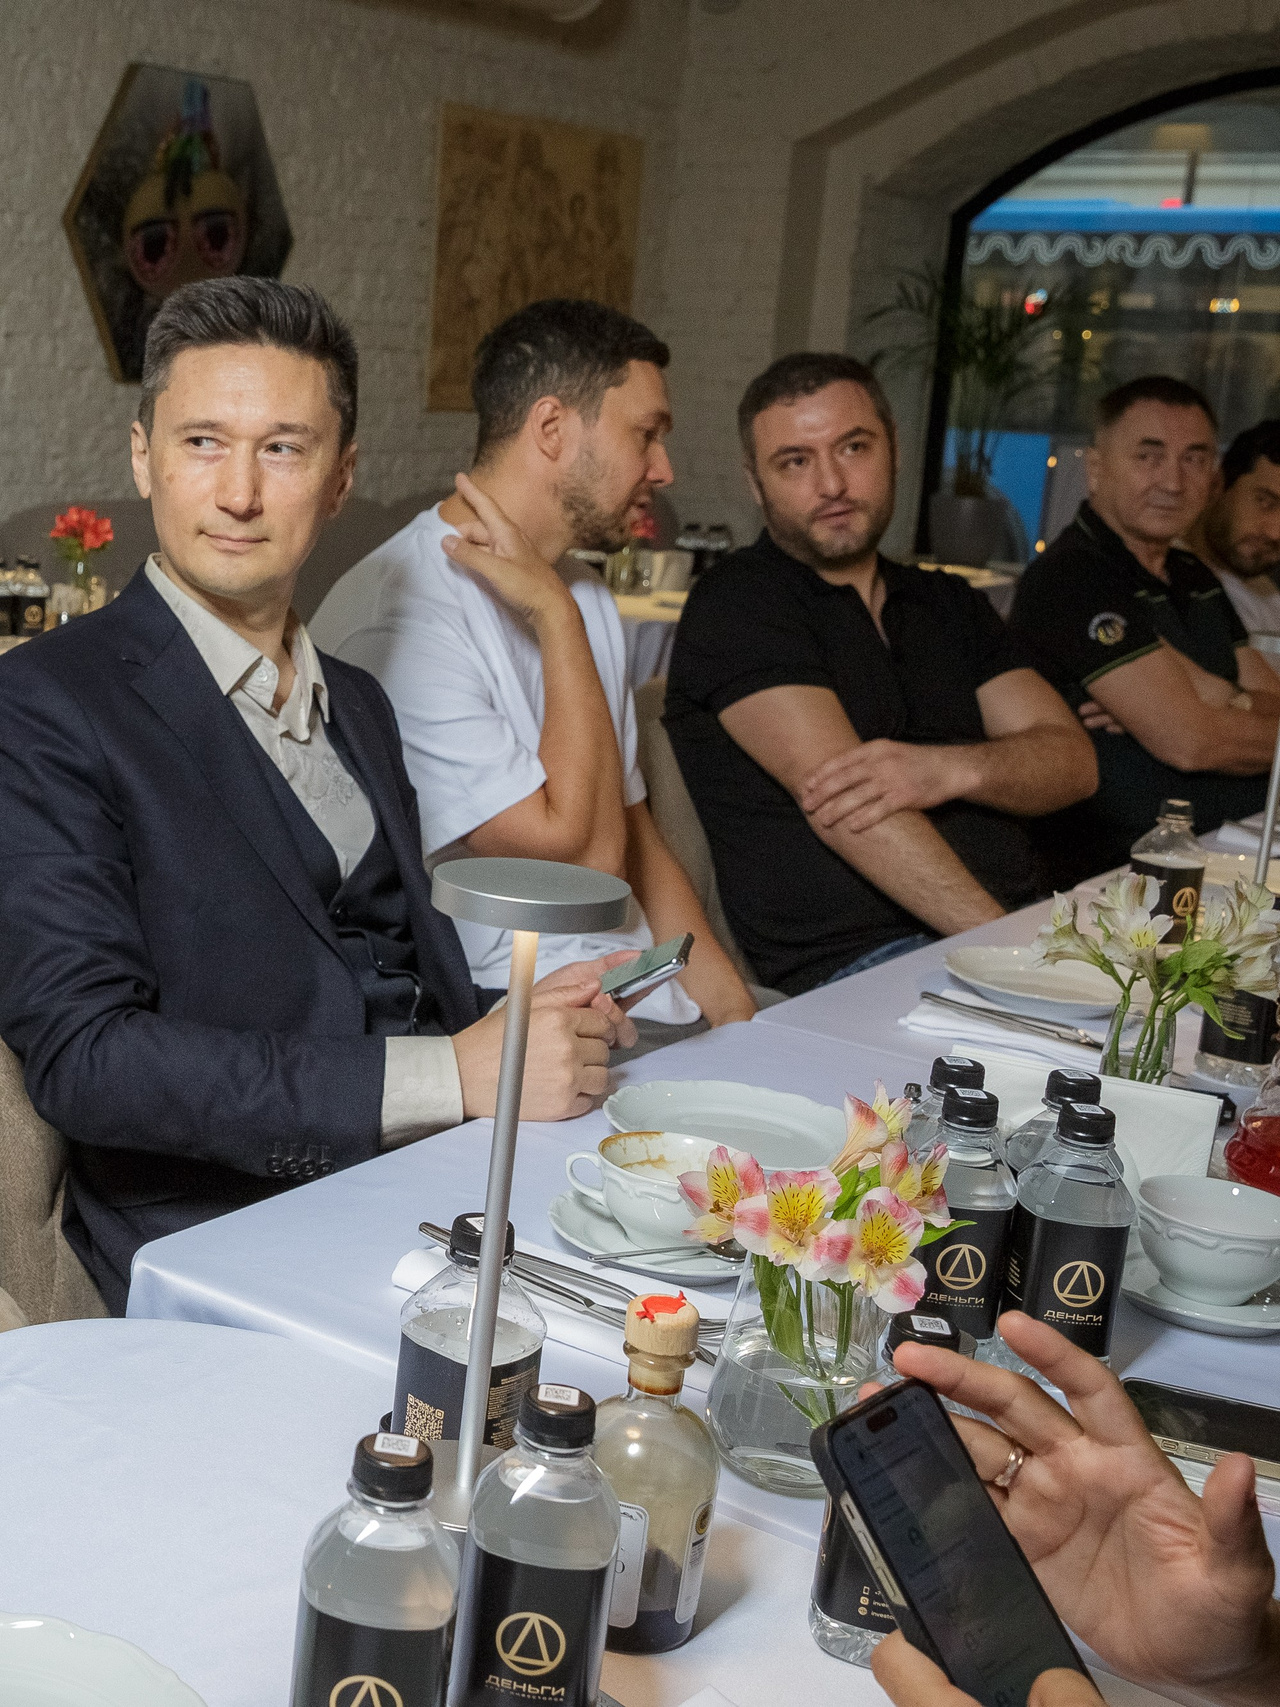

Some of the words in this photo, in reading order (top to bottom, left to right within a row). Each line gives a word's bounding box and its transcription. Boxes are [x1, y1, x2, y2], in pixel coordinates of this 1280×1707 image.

[926, 1292, 985, 1305] ДЕНЬГИ
[1043, 1309, 1103, 1322] ДЕНЬГИ
[485, 1674, 566, 1697] ДЕНЬГИ
